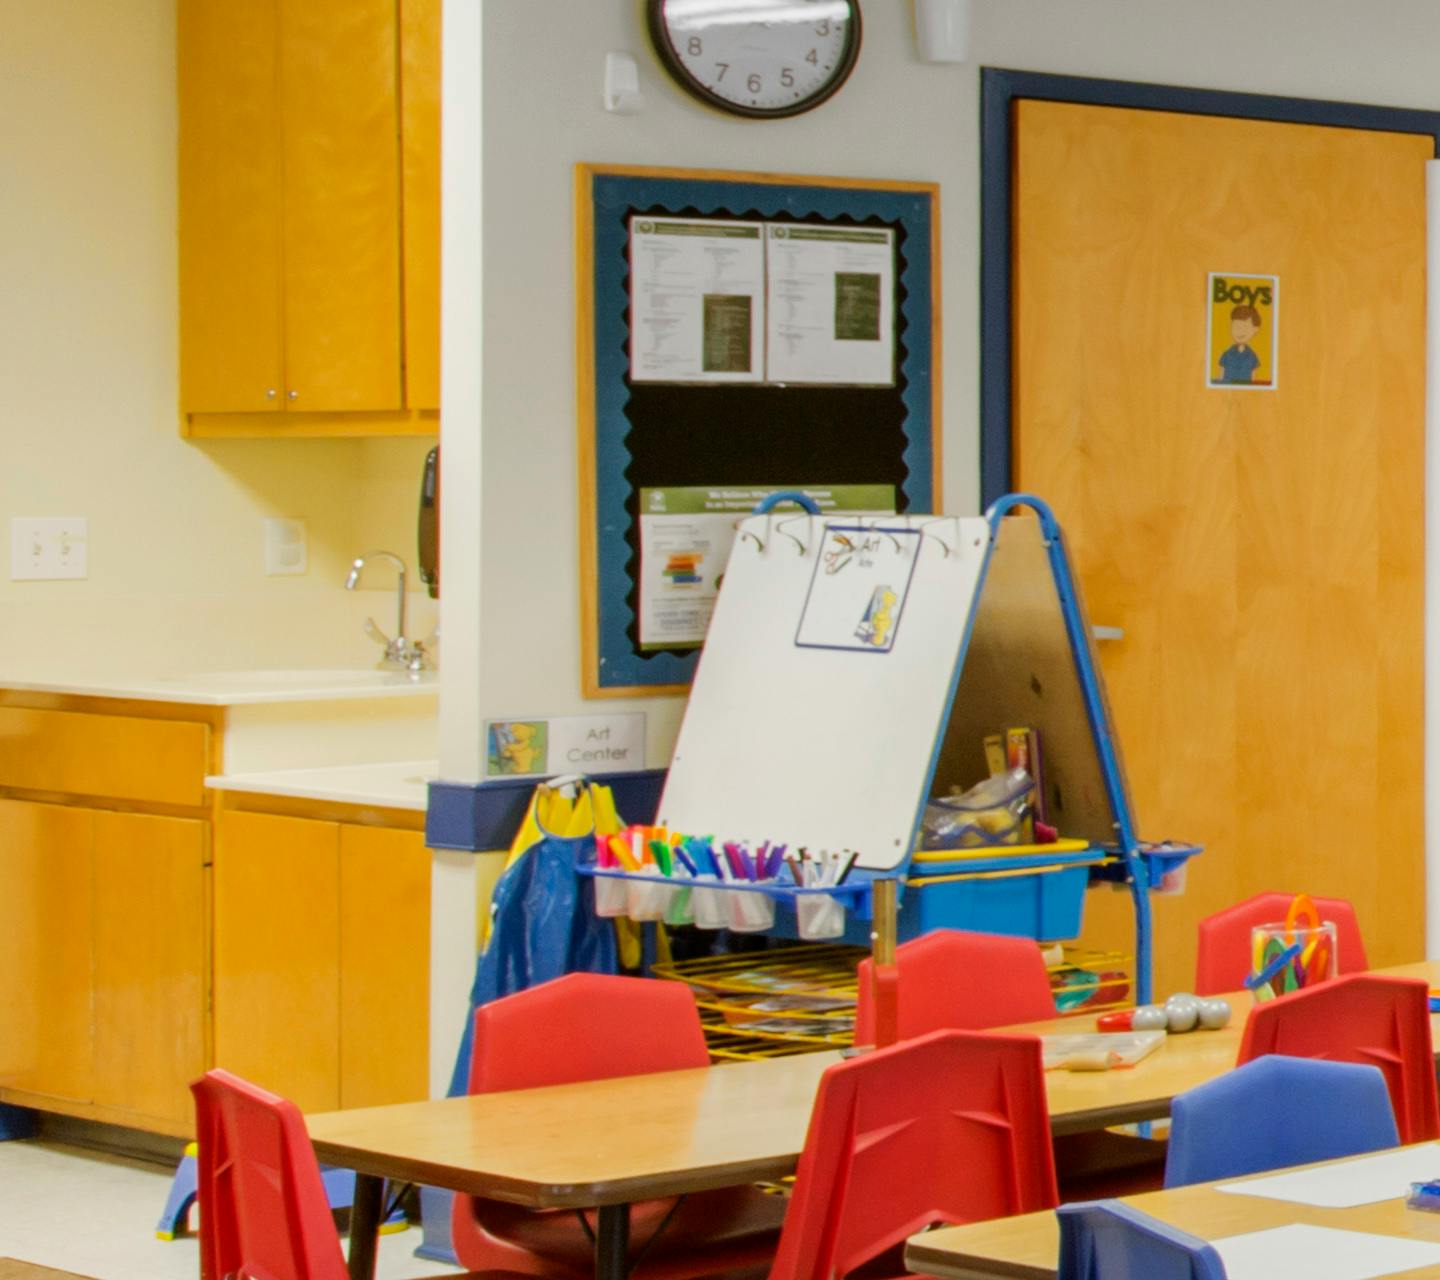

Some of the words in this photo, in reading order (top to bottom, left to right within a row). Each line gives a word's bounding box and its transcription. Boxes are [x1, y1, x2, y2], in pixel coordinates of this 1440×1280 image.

[815, 18, 830, 37] 3
[688, 37, 703, 57] 8
[805, 48, 818, 65] 4
[715, 63, 730, 83] 7
[781, 68, 795, 88] 5
[747, 74, 762, 94] 6
[1213, 277, 1273, 308] Boys
[860, 534, 882, 553] Art
[586, 727, 611, 742] Art
[566, 747, 629, 763] Center
